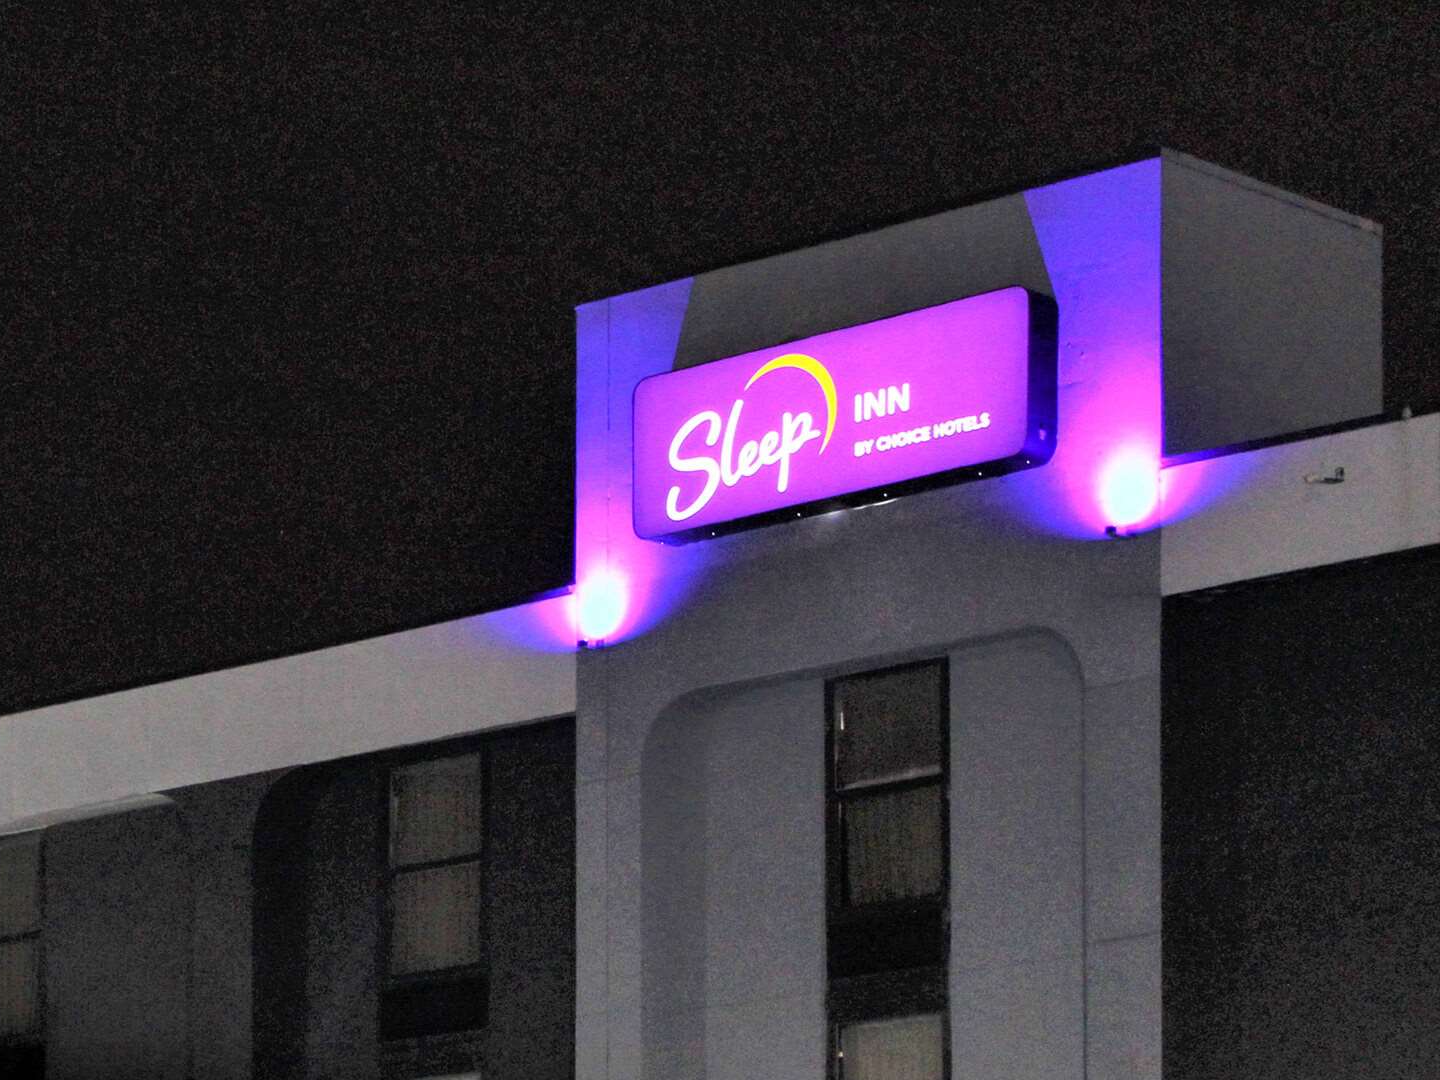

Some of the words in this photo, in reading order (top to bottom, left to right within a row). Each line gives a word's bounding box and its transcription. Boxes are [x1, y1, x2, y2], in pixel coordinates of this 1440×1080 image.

[854, 382, 911, 424] INN
[853, 439, 874, 457] BY
[875, 426, 932, 452] CHOICE
[932, 411, 991, 439] HOTELS
[666, 399, 822, 522] Sleep
